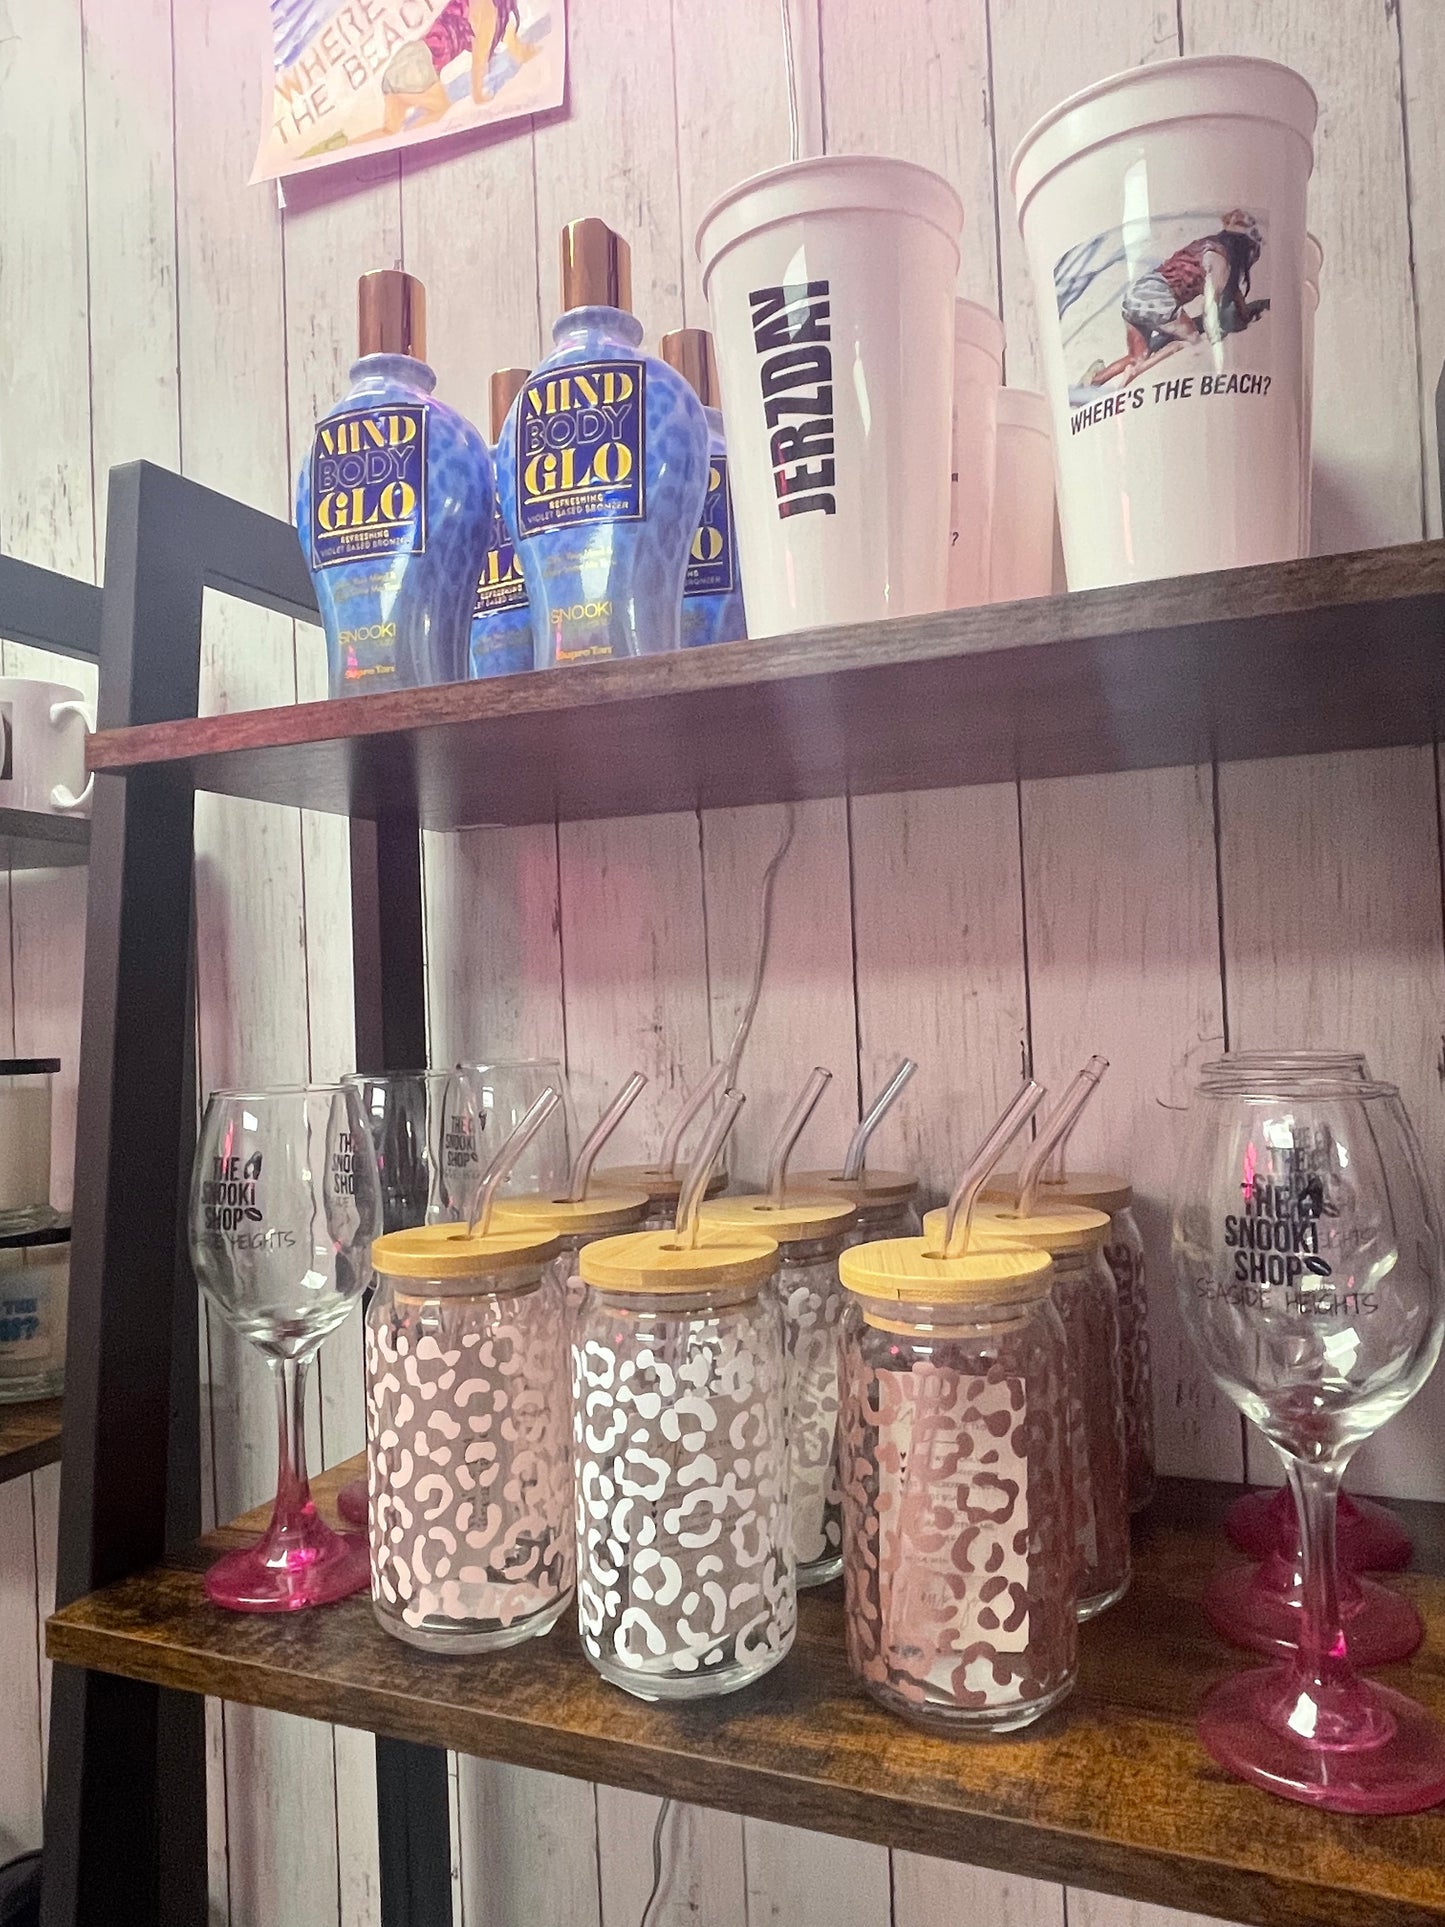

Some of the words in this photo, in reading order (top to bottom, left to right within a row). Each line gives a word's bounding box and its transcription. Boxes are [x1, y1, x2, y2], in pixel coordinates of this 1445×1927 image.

[272, 84, 336, 144] THE
[525, 371, 634, 420] MIND
[749, 280, 836, 520] JERZDAY
[1071, 387, 1145, 435] WHERE'S
[1152, 377, 1195, 404] THE
[1200, 373, 1271, 396] BEACH?
[318, 415, 417, 459] MIND
[525, 403, 633, 457] BODY
[318, 445, 415, 493] BODY
[524, 441, 633, 497] GLO
[317, 481, 417, 532] GLO
[549, 493, 603, 509] REFRESHING
[556, 506, 583, 518] BASED
[340, 529, 389, 544] REFRESHING
[338, 622, 396, 644] SNOOKI
[550, 601, 613, 624] SNOOKI
[1225, 1214, 1319, 1254] SNOOKI
[1234, 1250, 1301, 1287] SHOP
[1196, 1277, 1271, 1311] SEASIDE
[1285, 1290, 1379, 1317] HEIGHTS
